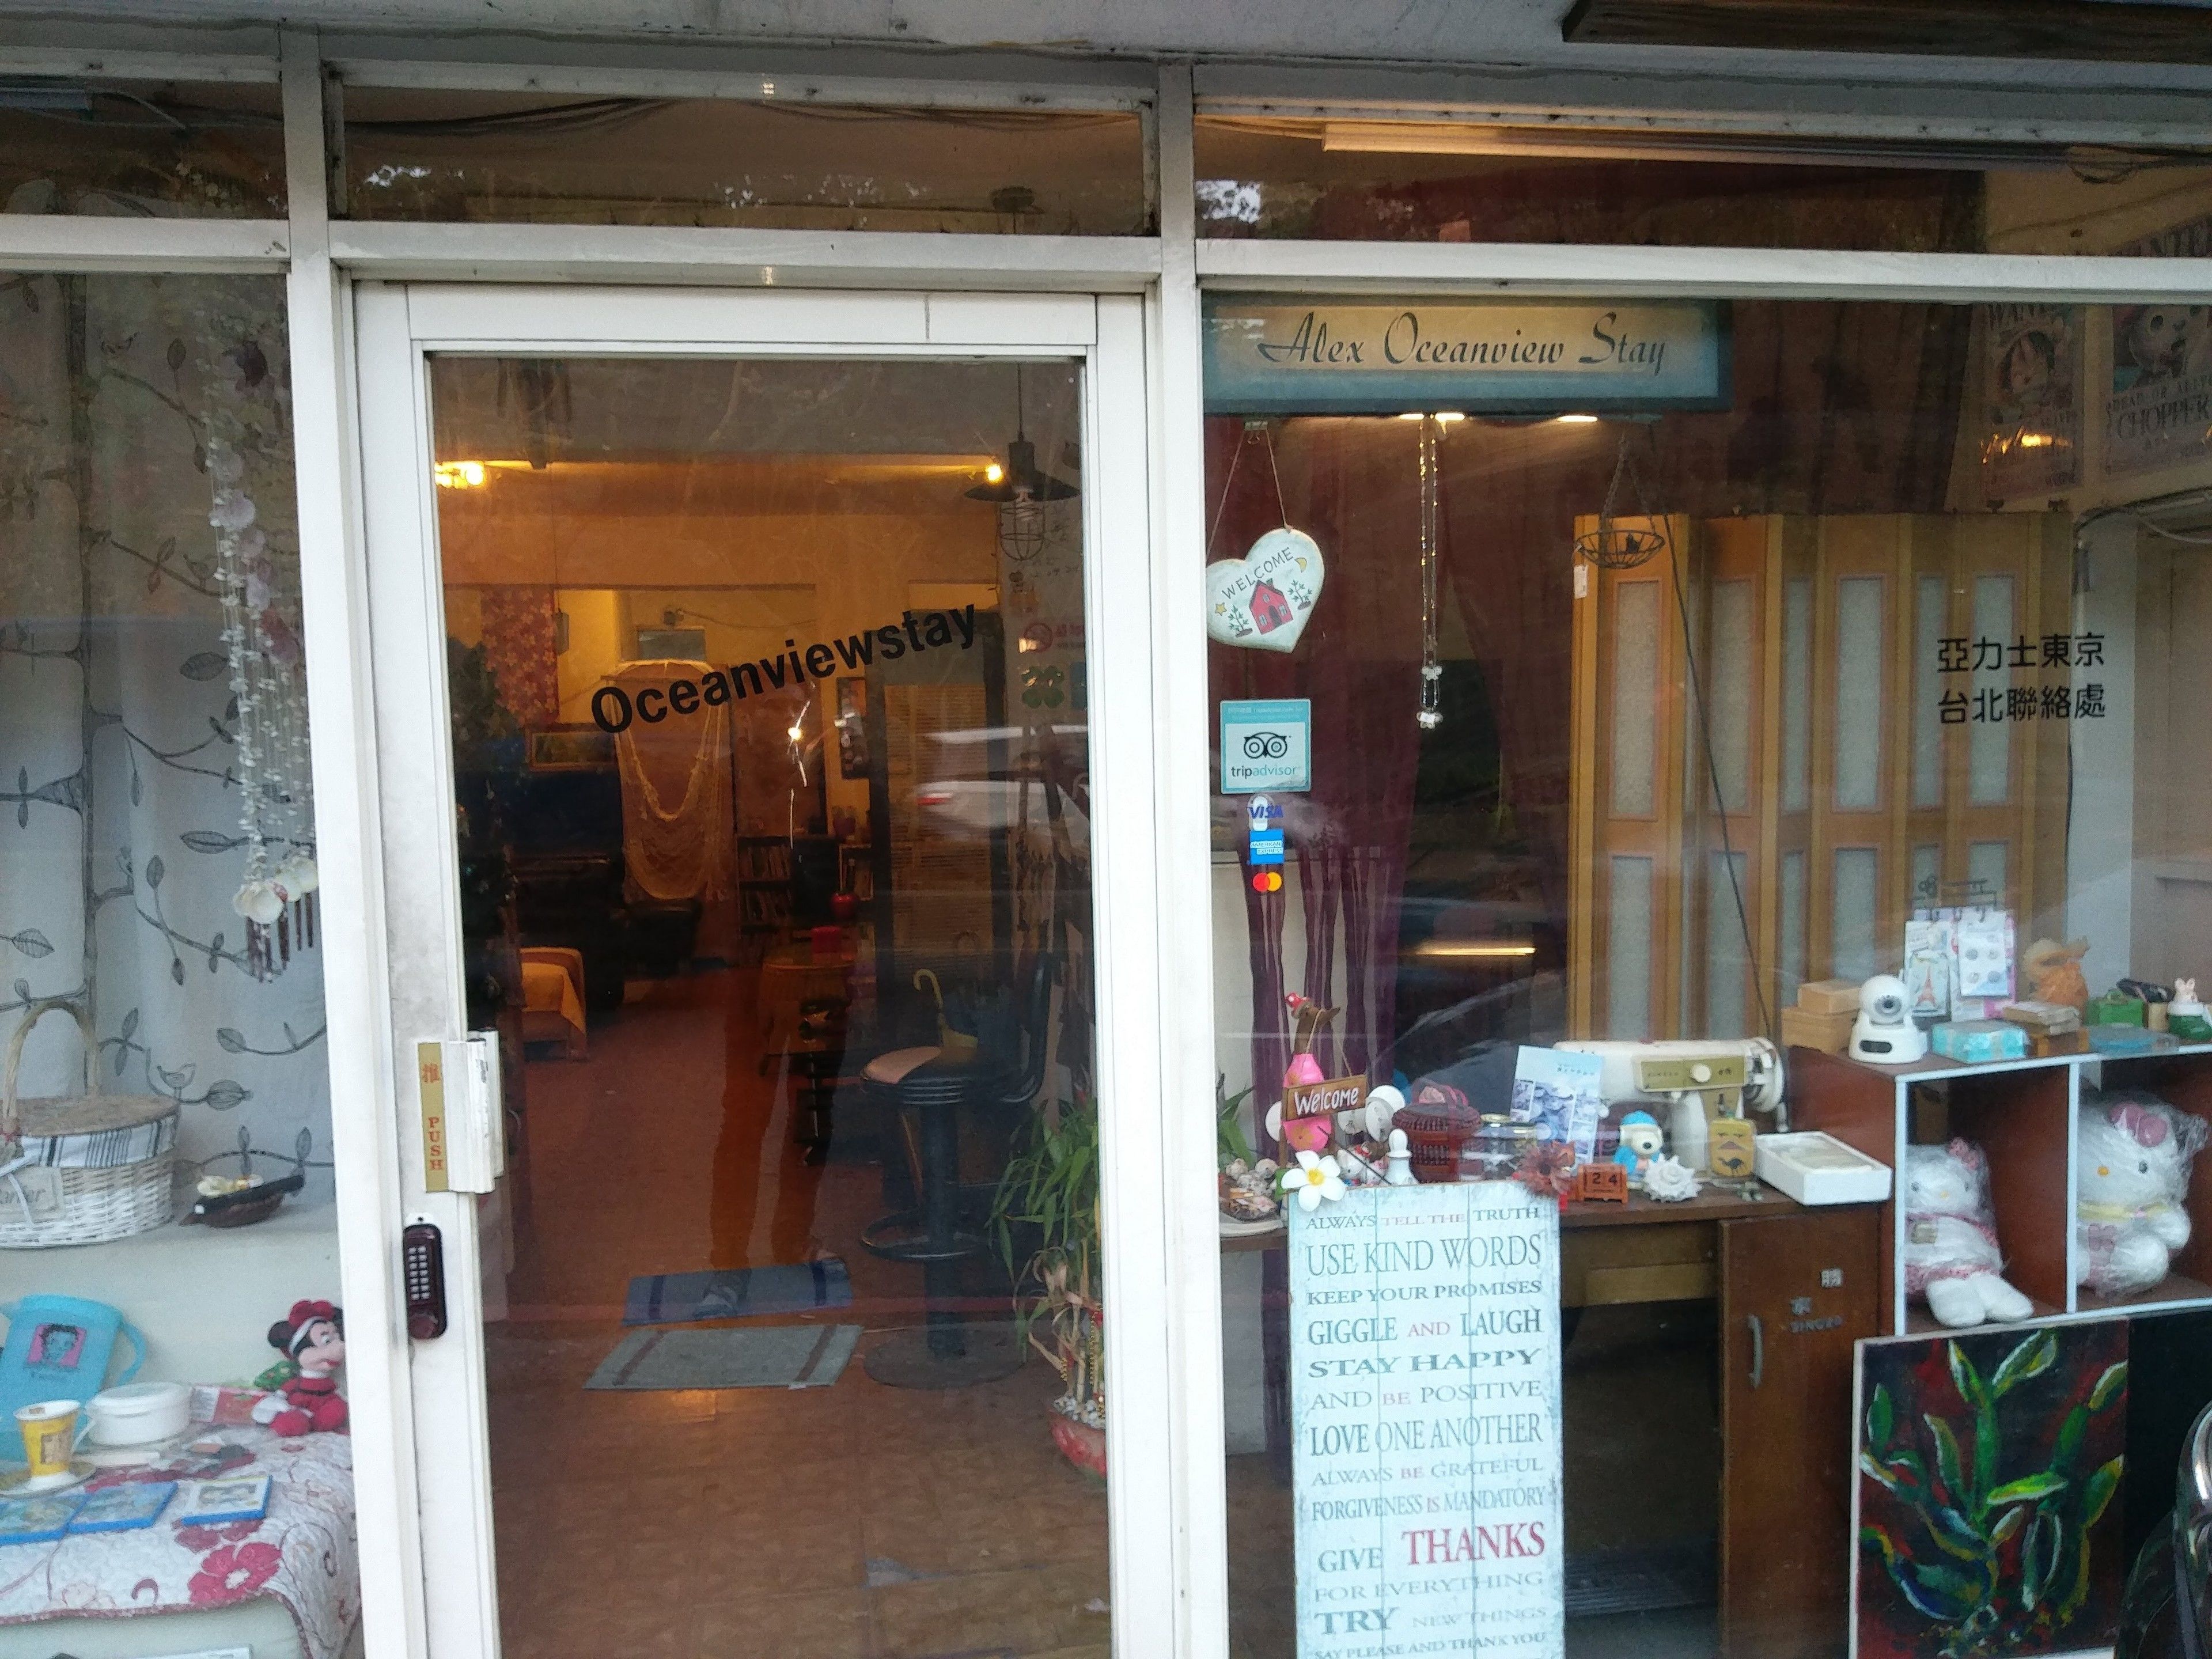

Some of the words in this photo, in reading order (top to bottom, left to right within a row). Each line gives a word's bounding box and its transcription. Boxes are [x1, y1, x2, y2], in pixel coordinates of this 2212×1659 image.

[1257, 312, 1365, 363] Alex
[1384, 311, 1565, 365] Oceanview
[1578, 311, 1666, 376] Stay
[1221, 547, 1294, 600] WELCOME
[591, 604, 976, 733] Oceanviewstay
[1937, 632, 2104, 673] 亞力士東京
[1937, 684, 2105, 725] 台北聯絡處
[1230, 764, 1298, 779] tripadvisor
[1247, 804, 1283, 819] VISA
[428, 1116, 444, 1171] PUSH
[1305, 1214, 1376, 1230] ALWAYS
[1381, 1216, 1425, 1227] TELL
[1428, 1214, 1465, 1224] THE
[1474, 1207, 1539, 1221] TRUTH
[1305, 1244, 1357, 1276] USE
[1364, 1240, 1434, 1273] KIND
[1440, 1234, 1541, 1268] WORDS
[1307, 1290, 1362, 1305] KEEP
[1364, 1287, 1429, 1302] YOUR
[1434, 1281, 1542, 1298] PROMISES
[1308, 1317, 1397, 1345] GIGGLE
[1407, 1322, 1450, 1338] AND
[1460, 1308, 1542, 1336] LAUGH
[1308, 1357, 1401, 1378] STAY
[1408, 1348, 1542, 1372] HAPPY
[1310, 1391, 1372, 1410] AND
[1382, 1392, 1411, 1406] BE
[1421, 1381, 1542, 1403] POSITIVE
[1310, 1423, 1369, 1456] LOVE
[1376, 1421, 1426, 1452] ONE
[1430, 1413, 1543, 1449] ANOTHER
[1312, 1467, 1393, 1486] ALWAYS
[1400, 1466, 1425, 1479] BE
[1430, 1457, 1543, 1478] GRATEFUL
[1312, 1495, 1422, 1521] FORGIVENESS
[1426, 1497, 1440, 1513] IS
[1442, 1486, 1546, 1512] MANDATORY
[1317, 1547, 1383, 1572] GIVE
[1401, 1521, 1545, 1566] THANKS
[1315, 1586, 1366, 1603] FOR
[1374, 1572, 1543, 1597] EVERYTHING
[1314, 1607, 1399, 1635] TRY
[1412, 1614, 1460, 1627] NEW
[1465, 1607, 1546, 1623] THINGS
[1315, 1649, 1343, 1659] SAY
[1347, 1645, 1403, 1658] PLEASE
[1408, 1641, 1446, 1653] AND
[1448, 1634, 1508, 1650] THANK
[1512, 1632, 1546, 1643] YOU
